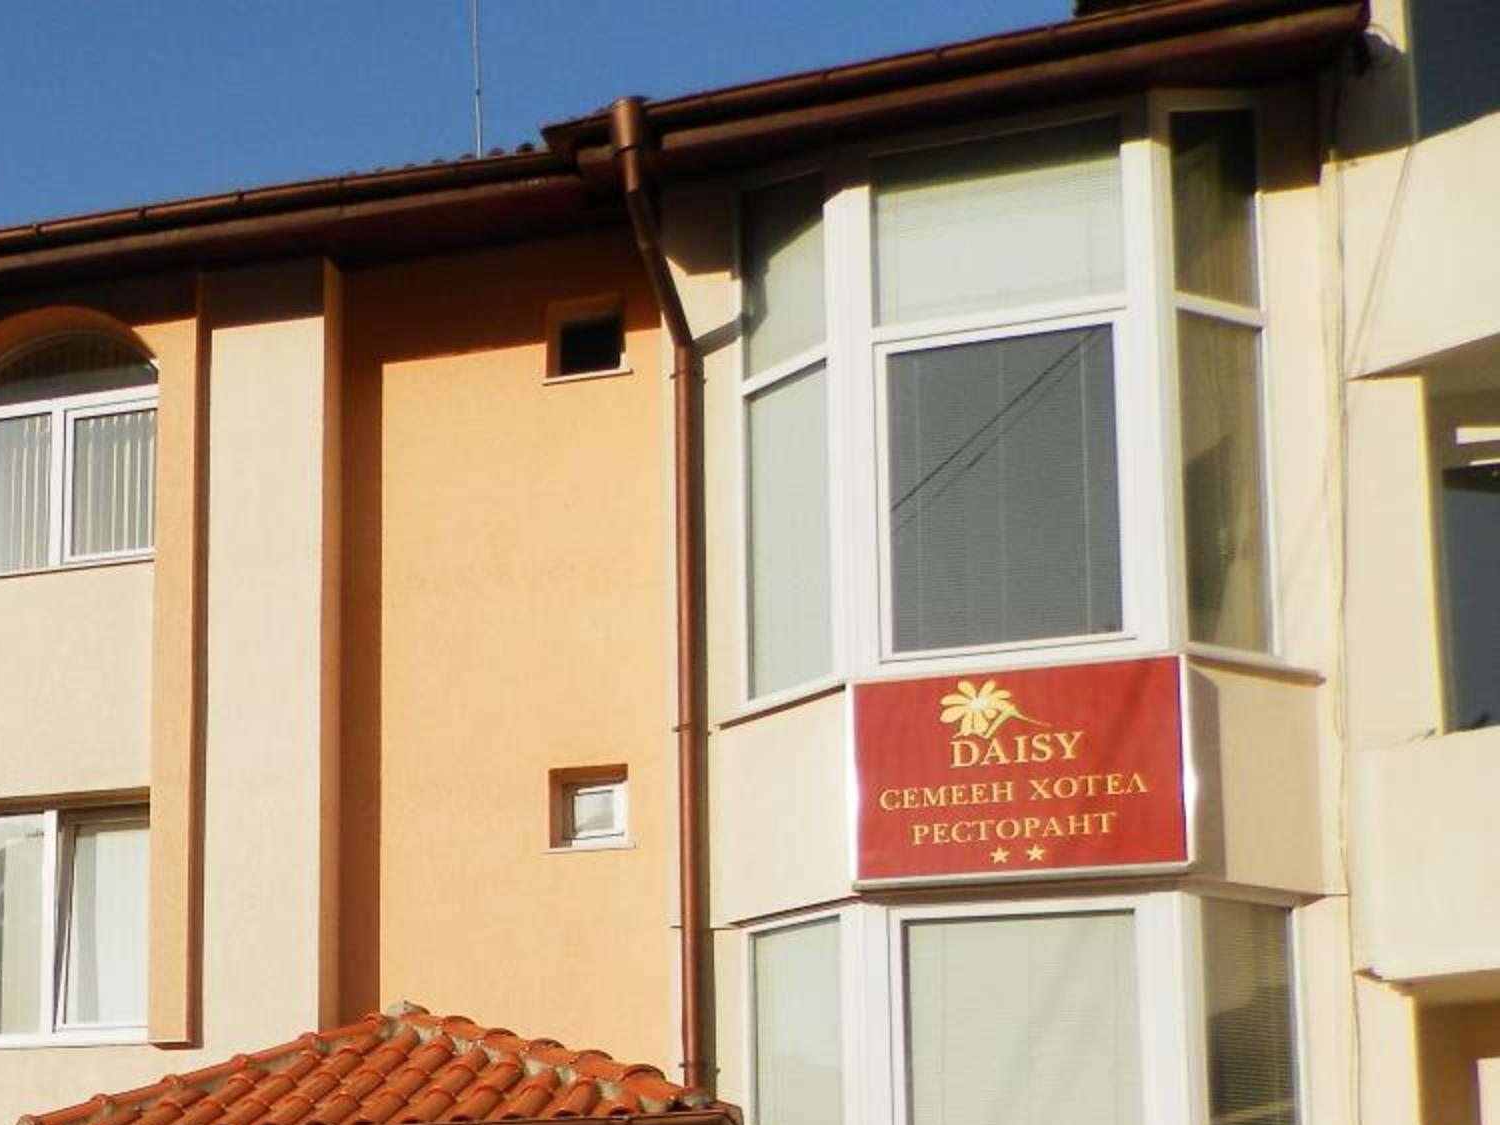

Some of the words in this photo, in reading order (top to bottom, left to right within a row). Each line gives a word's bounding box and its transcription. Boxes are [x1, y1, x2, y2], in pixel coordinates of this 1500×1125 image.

[951, 731, 1083, 768] DAISY
[880, 782, 1014, 811] СЕМЕЕН
[1029, 773, 1147, 801] ХОТЕЛ
[912, 812, 1117, 845] РЕСТОРАНТ
